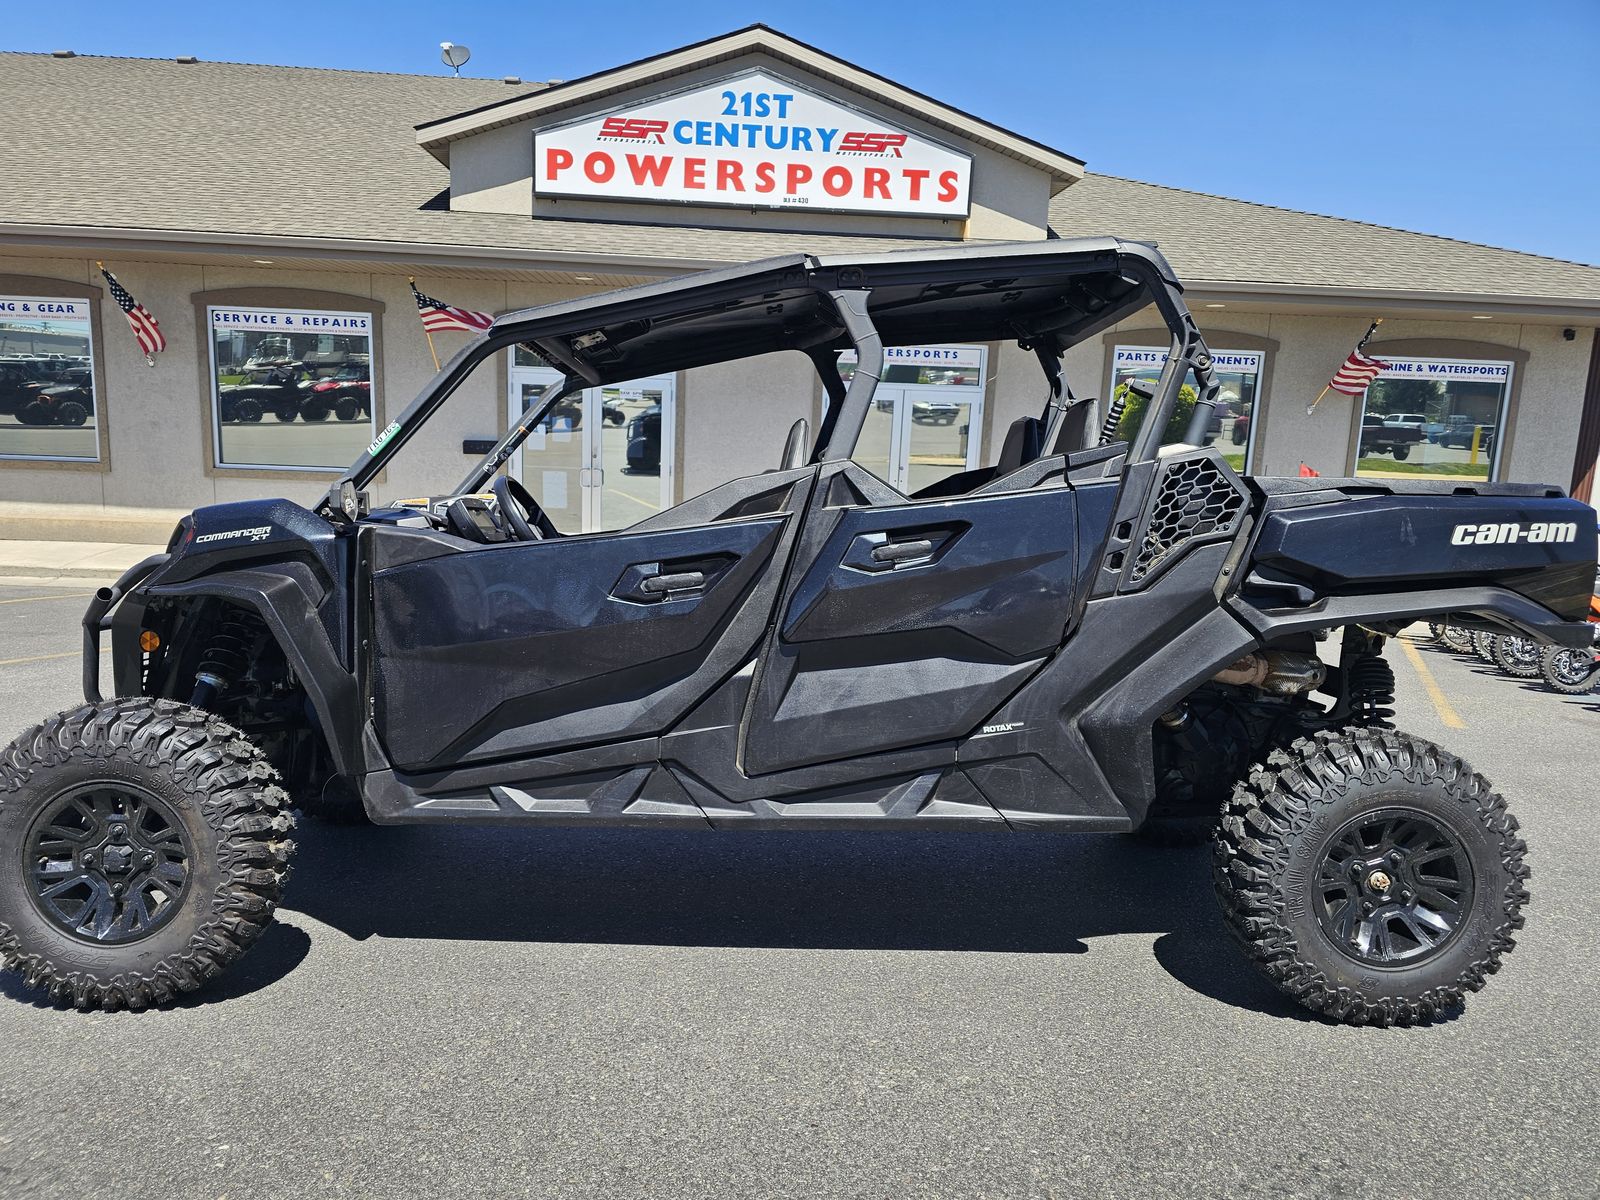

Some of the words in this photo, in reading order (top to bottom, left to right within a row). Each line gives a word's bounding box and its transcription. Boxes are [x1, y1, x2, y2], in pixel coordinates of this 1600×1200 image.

[721, 90, 794, 119] 21ST
[599, 117, 669, 144] SSR
[673, 120, 839, 152] CENTURY
[838, 132, 908, 158] SSR
[546, 148, 959, 203] POWERSPORTS
[22, 303, 31, 312] &
[38, 304, 75, 313] GEAR
[215, 313, 277, 324] SERVICE
[285, 316, 293, 325] &
[302, 317, 366, 328] REPAIRS
[854, 347, 959, 359] ERSPORTS
[1117, 352, 1157, 362] PARTS
[1161, 353, 1169, 362] &
[1211, 356, 1256, 366] ONENTS
[1384, 363, 1413, 372] RINE
[1416, 365, 1424, 373] &
[1428, 364, 1507, 376] WATERSPORTS
[196, 526, 272, 543] COMMANDER
[251, 533, 270, 542] XT
[1451, 522, 1577, 545] can-am
[983, 723, 1013, 733] ROTAX
[82, 757, 144, 782] TRAIL
[1286, 867, 1306, 922] TRAIL
